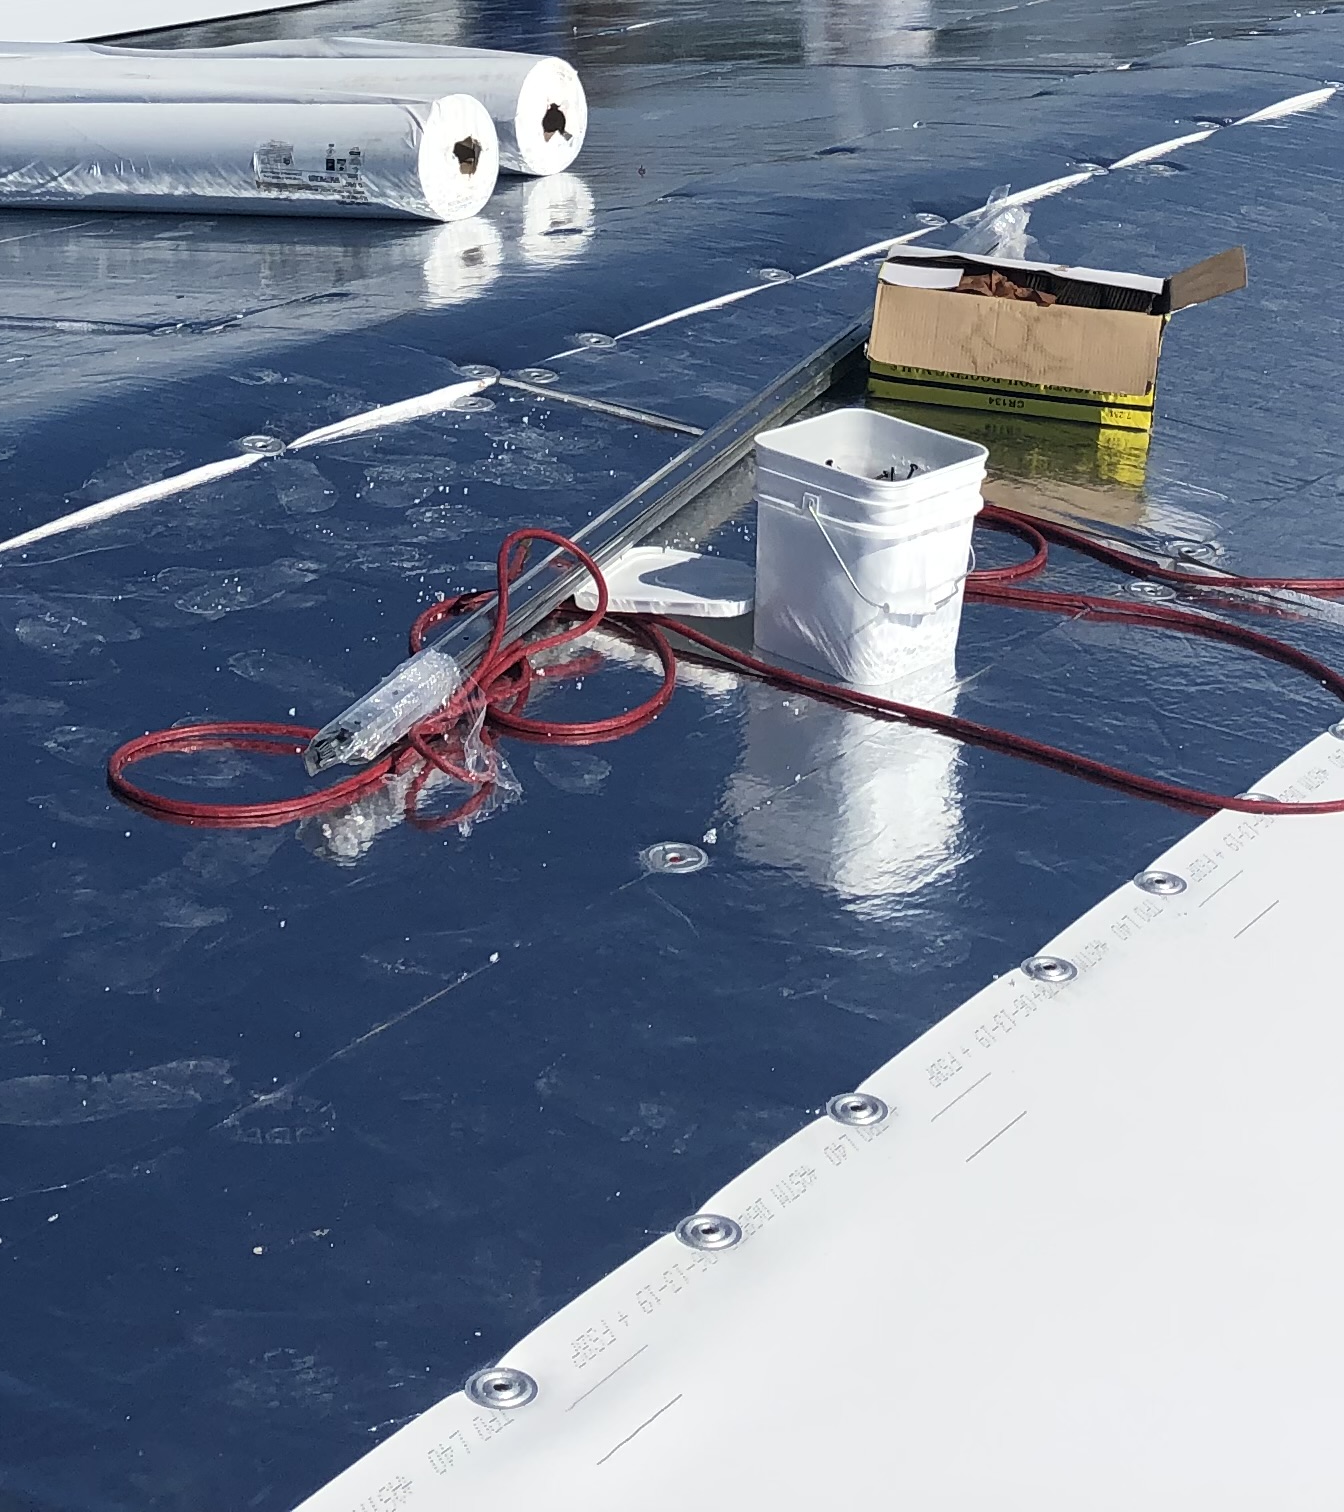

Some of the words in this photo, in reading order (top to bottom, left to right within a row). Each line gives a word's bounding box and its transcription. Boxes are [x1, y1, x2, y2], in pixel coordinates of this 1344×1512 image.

[988, 396, 1025, 409] CR134
[823, 1133, 860, 1167] L40
[427, 1429, 471, 1476] L40
